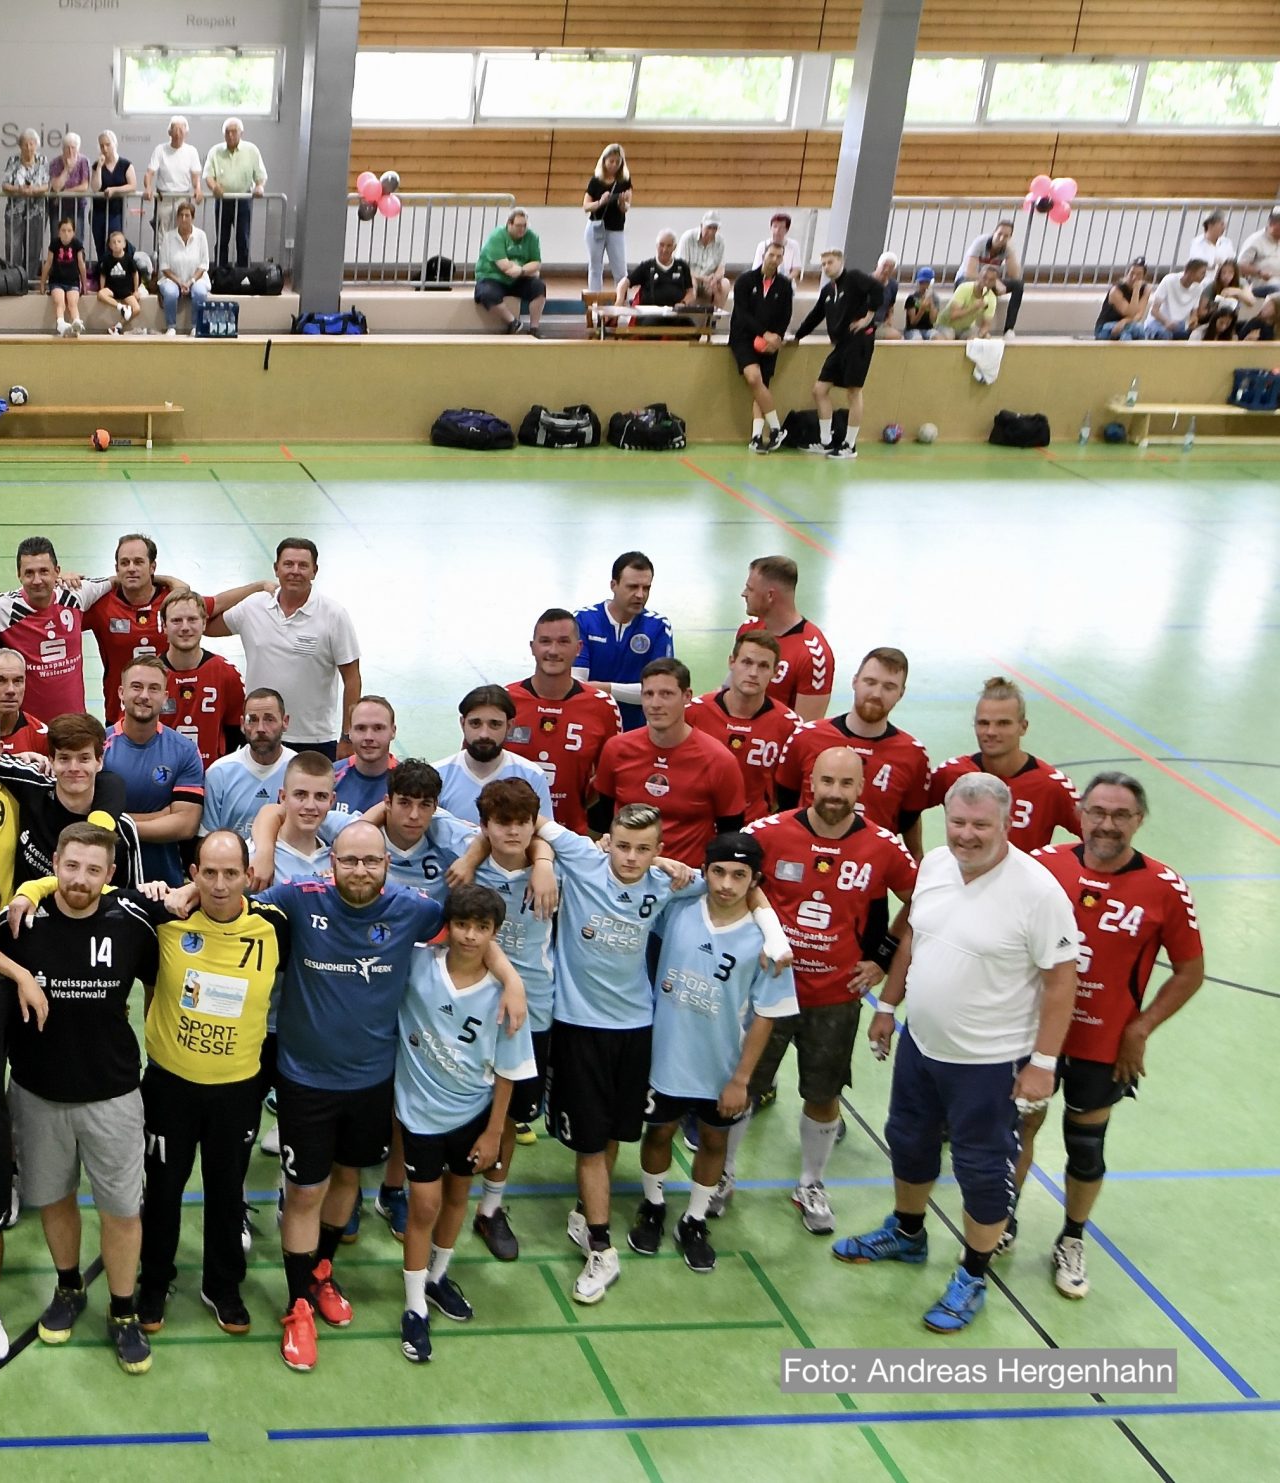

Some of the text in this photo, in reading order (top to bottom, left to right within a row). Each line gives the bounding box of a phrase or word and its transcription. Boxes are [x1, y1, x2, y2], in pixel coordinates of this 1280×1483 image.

[186, 14, 236, 28] Respekt
[1, 122, 70, 148] Siel
[60, 609, 74, 632] 9
[201, 687, 217, 713] 2
[564, 723, 583, 751] 5
[746, 738, 778, 767] 20
[873, 764, 891, 792] 4
[422, 855, 438, 880] 6
[837, 860, 872, 891] 84
[639, 894, 657, 918] 8
[1098, 899, 1144, 937] 24
[311, 914, 328, 930] TS
[90, 936, 112, 968] 14
[238, 937, 263, 971] 71
[304, 958, 393, 973] GESUNDHEITS WERK
[713, 952, 736, 982] 3
[51, 978, 120, 989] Kreissparkasse
[51, 989, 107, 999] Westerwald
[179, 1016, 238, 1040] SPORT-
[457, 1016, 482, 1044] 5
